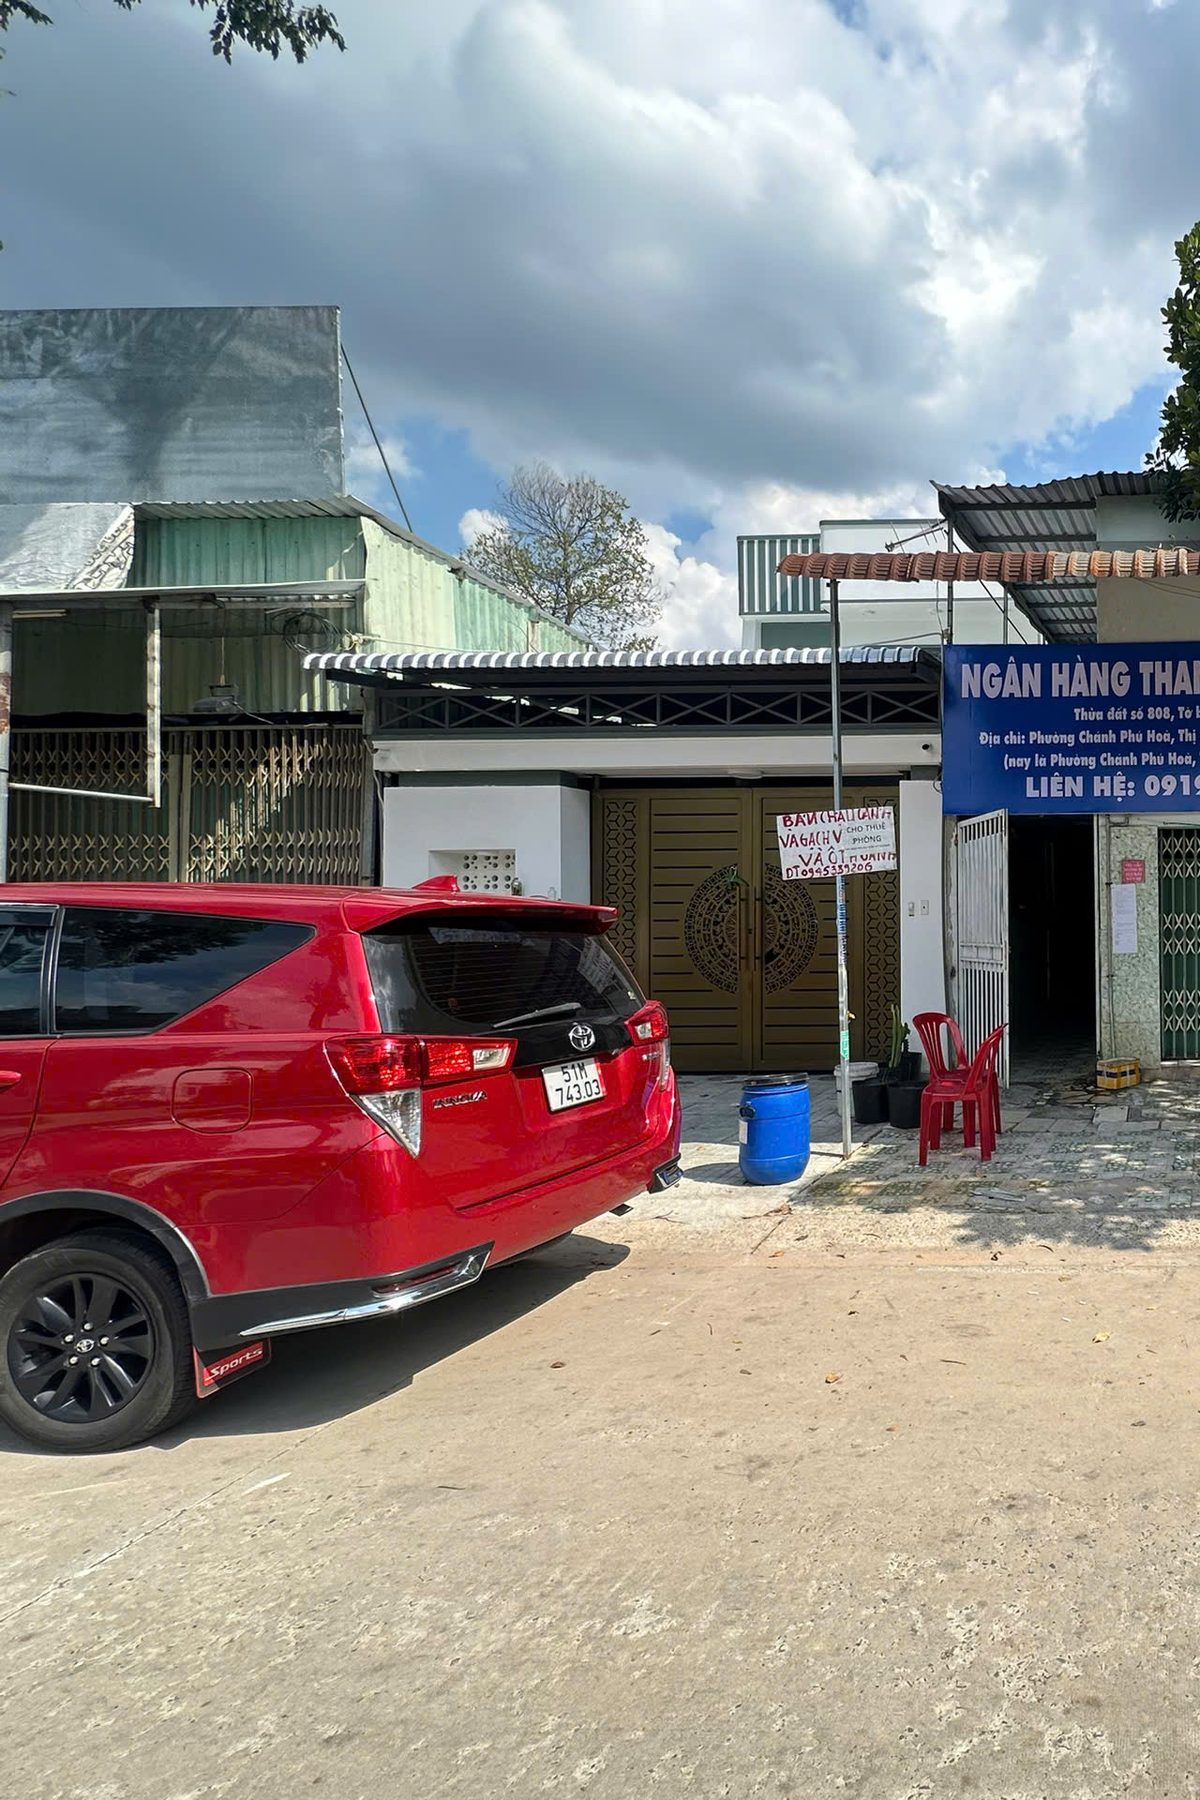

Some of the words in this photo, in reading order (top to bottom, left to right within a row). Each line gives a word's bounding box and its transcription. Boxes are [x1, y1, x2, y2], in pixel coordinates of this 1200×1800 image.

[961, 656, 1041, 699] NGÂN
[1051, 654, 1131, 697] HÀNG
[1107, 706, 1127, 721] đất
[1130, 705, 1144, 720] số
[1147, 706, 1175, 722] 808,
[1177, 706, 1193, 719] Tờ
[979, 731, 1001, 748] Địa
[1029, 730, 1075, 747] Phường
[1079, 729, 1116, 744] Chánh
[1120, 729, 1143, 743] Phú
[1178, 728, 1197, 744] Thị
[1003, 753, 1031, 770] (nay
[1034, 753, 1047, 767] là
[1050, 752, 1096, 769] Phường
[1100, 752, 1138, 767] Chánh
[1141, 751, 1165, 766] Phú
[1025, 771, 1084, 798] LIÊN
[1093, 771, 1136, 802] HỆ:
[560, 1062, 588, 1083] 51M
[555, 1078, 601, 1106] 743.03
[204, 1348, 263, 1382] Sports
